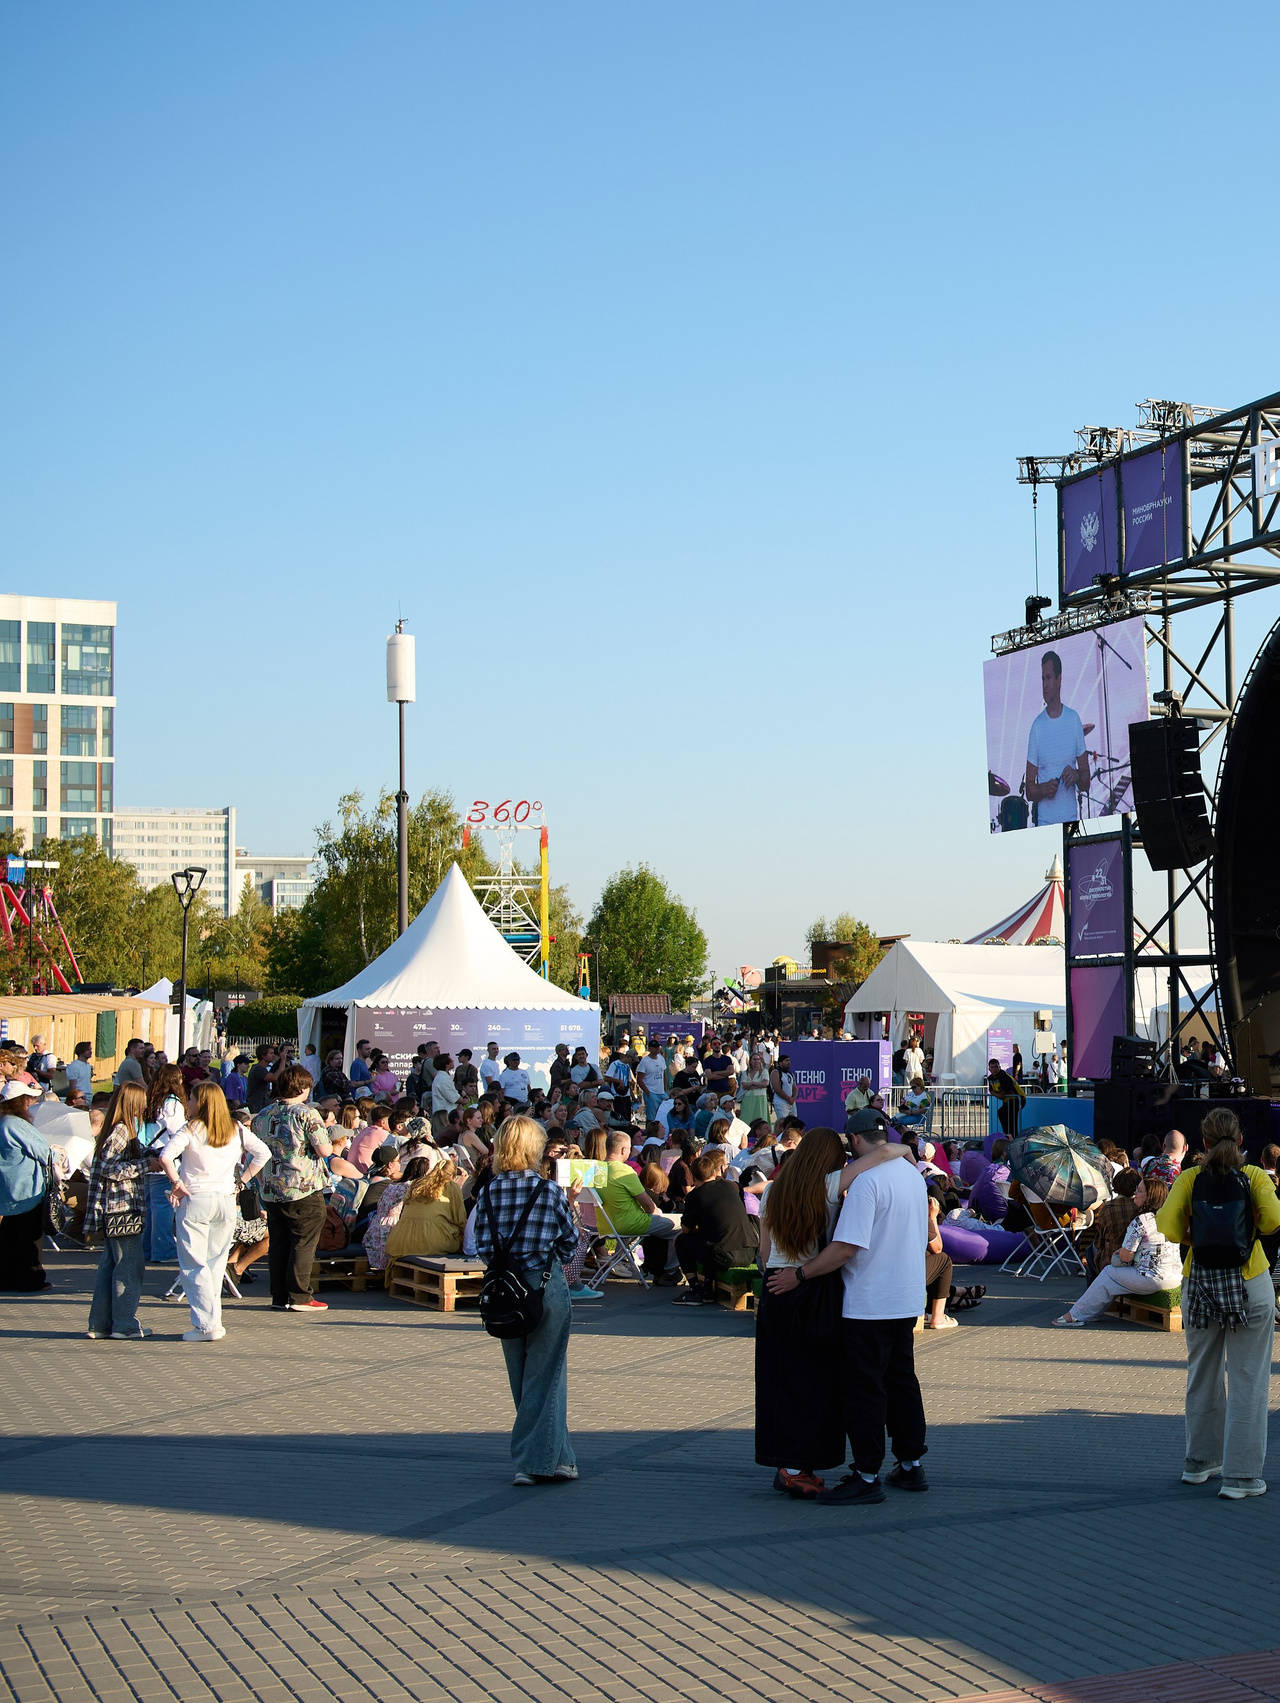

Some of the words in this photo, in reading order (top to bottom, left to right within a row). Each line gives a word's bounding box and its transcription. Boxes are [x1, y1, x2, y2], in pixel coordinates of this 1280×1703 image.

[1132, 496, 1172, 516] МИНОБРНАУКИ
[1132, 513, 1153, 526] РОССИИ
[795, 1070, 826, 1084] ТЕХНО
[841, 1068, 872, 1082] ТЕХНО
[797, 1087, 818, 1100] АРТ
